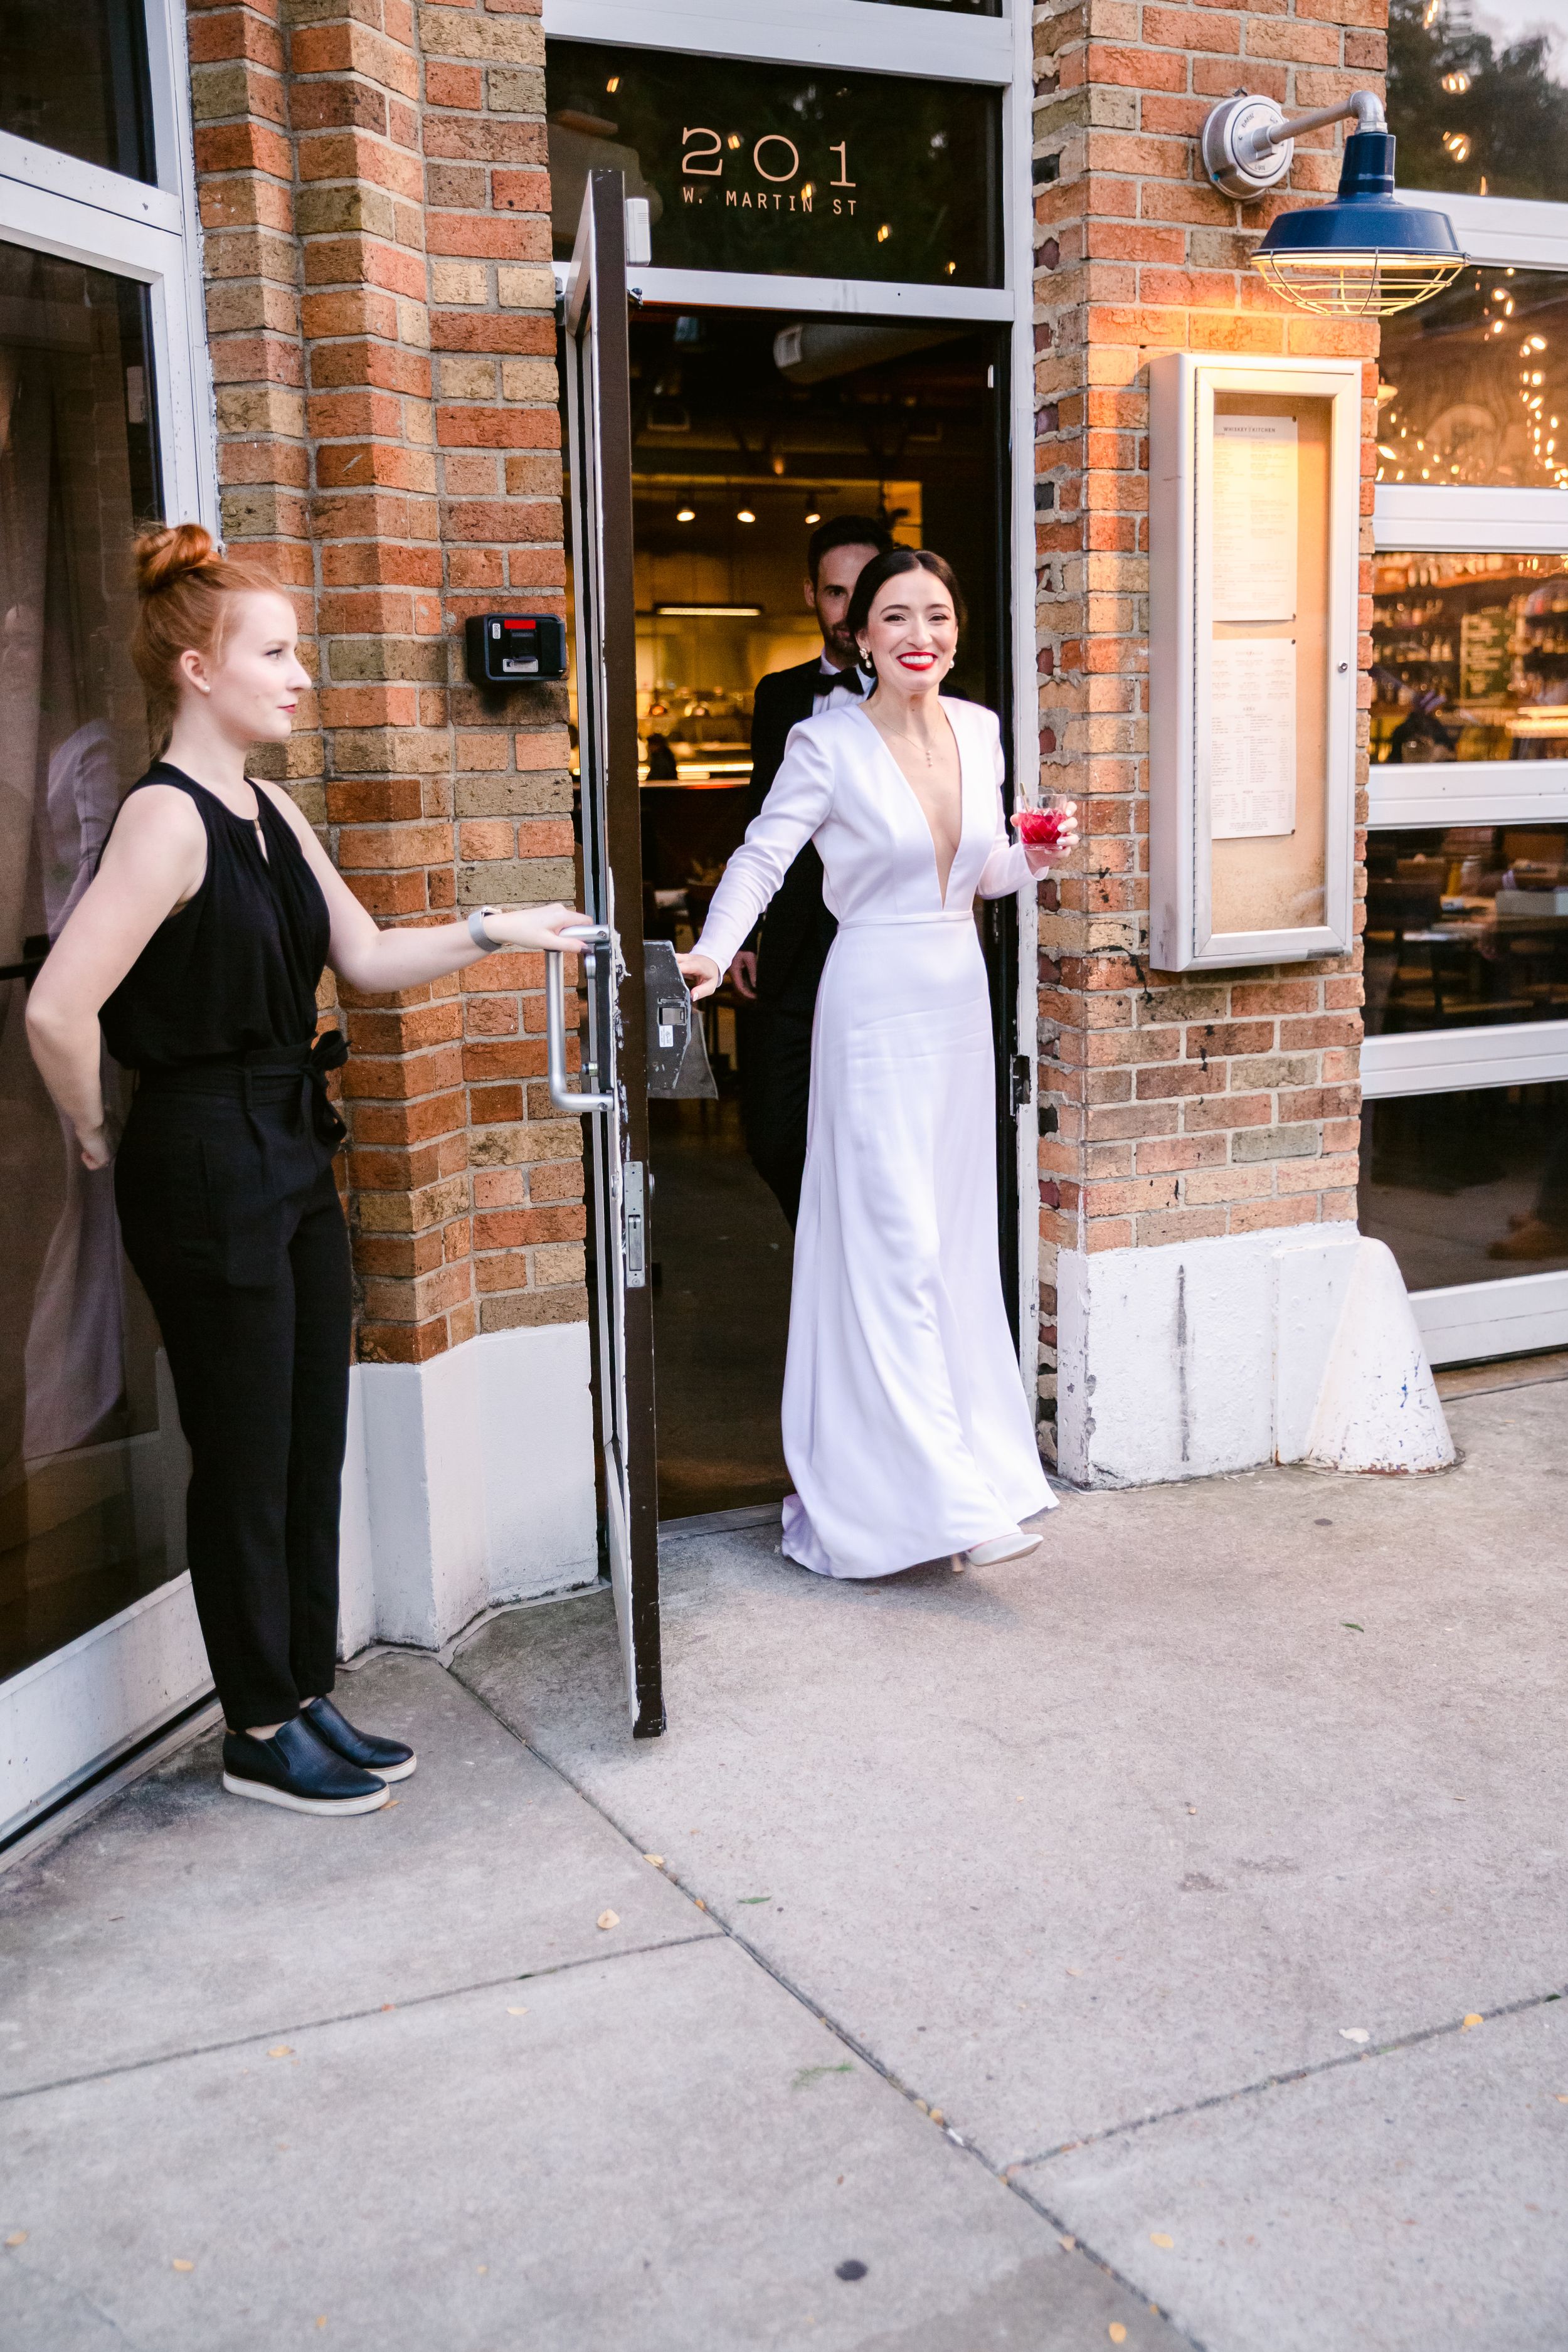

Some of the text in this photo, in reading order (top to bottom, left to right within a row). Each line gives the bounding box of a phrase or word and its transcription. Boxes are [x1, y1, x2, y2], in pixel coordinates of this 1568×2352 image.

[682, 127, 856, 188] 201
[682, 187, 857, 216] W. MARTIN ST
